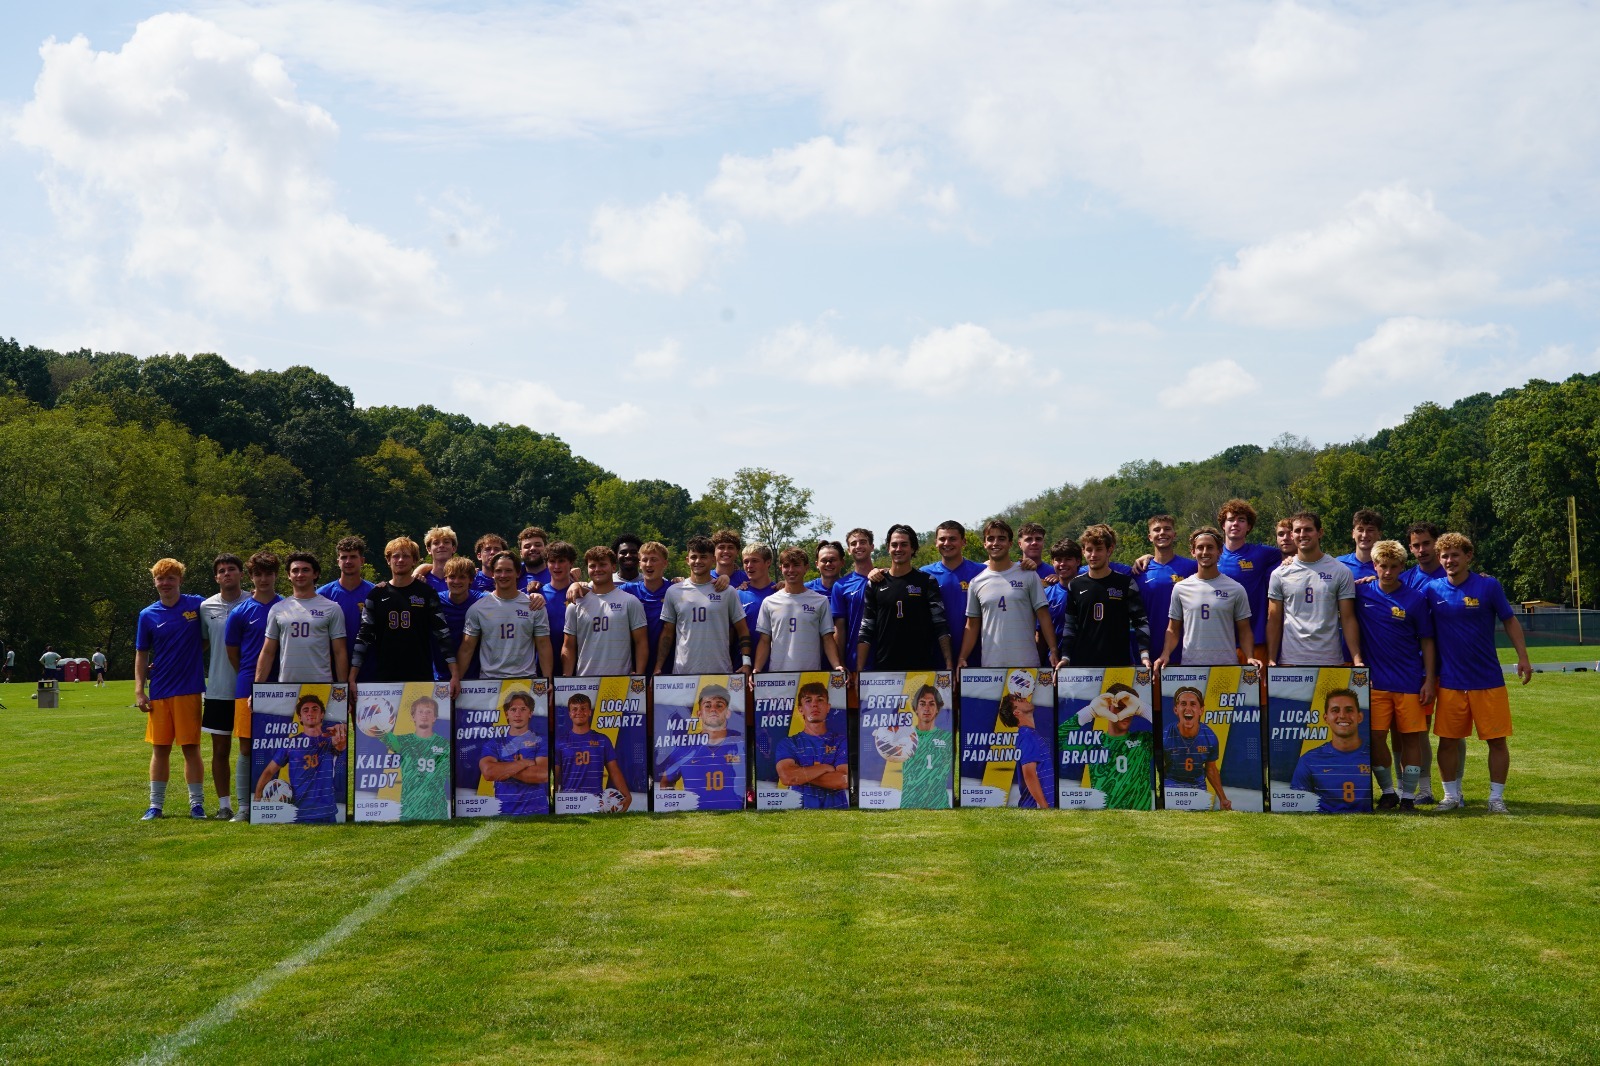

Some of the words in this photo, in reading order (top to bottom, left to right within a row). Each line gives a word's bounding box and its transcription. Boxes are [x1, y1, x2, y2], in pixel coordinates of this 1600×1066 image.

[1318, 572, 1332, 580] Pitt
[708, 592, 722, 600] Pitt
[1214, 590, 1228, 598] Pitt
[1305, 587, 1314, 604] 8
[802, 604, 815, 612] Pitt
[896, 600, 904, 618] 1
[998, 595, 1007, 612] 4
[516, 609, 529, 617] Pitt
[692, 606, 706, 622] 10
[1094, 602, 1104, 620] 0
[1201, 604, 1210, 620] 6
[388, 610, 411, 629] 99
[593, 616, 608, 632] 20
[789, 618, 796, 632] 9
[291, 622, 310, 638] 30
[500, 623, 515, 639] 12
[601, 699, 639, 712] LOGAN
[756, 699, 794, 711] ETHAN
[867, 695, 908, 709] BRETT
[1220, 693, 1245, 706] BEN
[466, 710, 500, 723] JOHN
[597, 715, 643, 728] SWARTZ
[761, 715, 790, 728] ROSE
[862, 712, 913, 727] BARNES
[1205, 710, 1260, 724] PITTMAN
[1280, 710, 1319, 724] LUCAS
[265, 722, 299, 734] CHRIS
[666, 718, 698, 730] MATT
[456, 726, 510, 740] GUTOSKY
[967, 733, 1019, 745] VINCENT
[1068, 731, 1103, 745] NICK
[1272, 727, 1328, 740] PITTMAN
[253, 737, 310, 750] BRANCATO
[655, 734, 709, 747] ARMENIO
[356, 754, 401, 769] KALEB
[575, 751, 590, 765] 20
[926, 754, 933, 769] 1
[962, 749, 1022, 762] PADALINO
[1062, 750, 1108, 764] BRAUN
[417, 758, 436, 773] 99
[1116, 755, 1128, 773] 0
[1185, 758, 1193, 771] 6
[360, 773, 398, 788] EDDY
[705, 771, 724, 790] 10
[1343, 781, 1355, 802] 8
